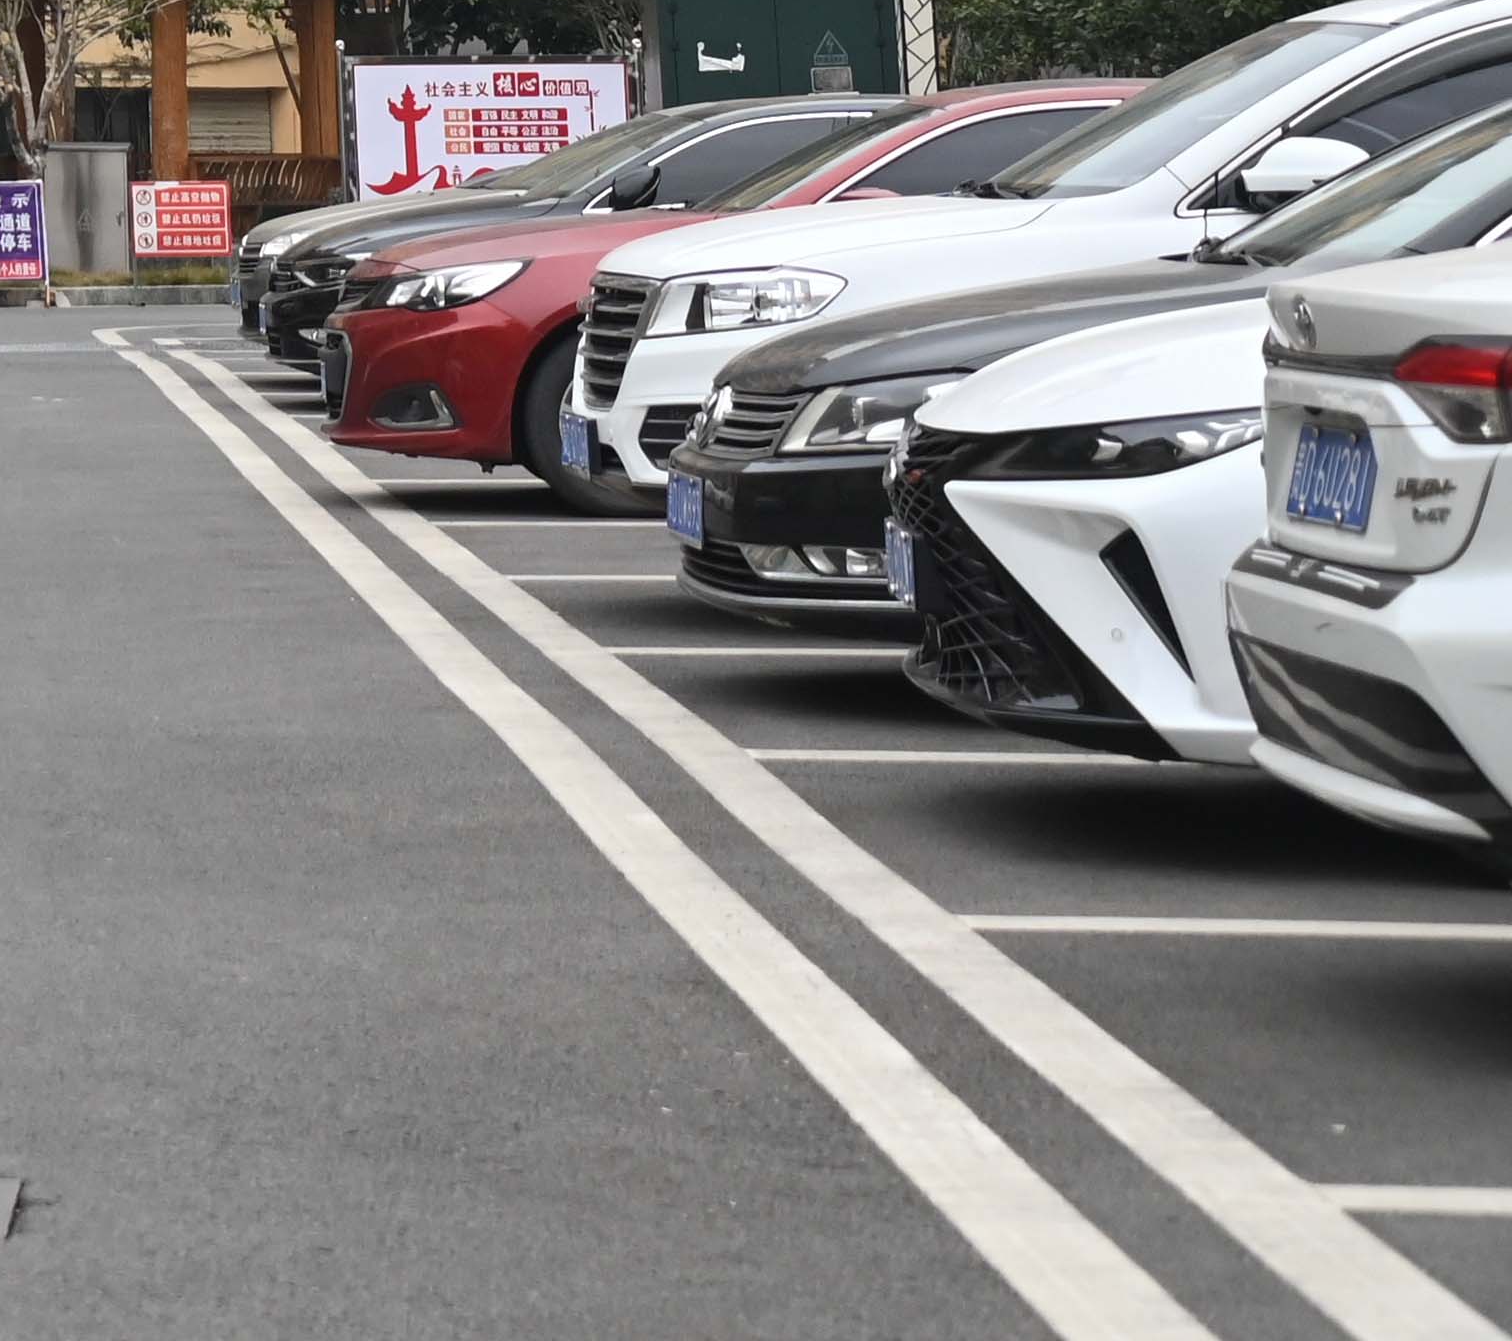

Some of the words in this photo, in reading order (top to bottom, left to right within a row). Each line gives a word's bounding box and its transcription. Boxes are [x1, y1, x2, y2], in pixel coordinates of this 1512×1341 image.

[425, 73, 589, 98] 社会主义核心价值观
